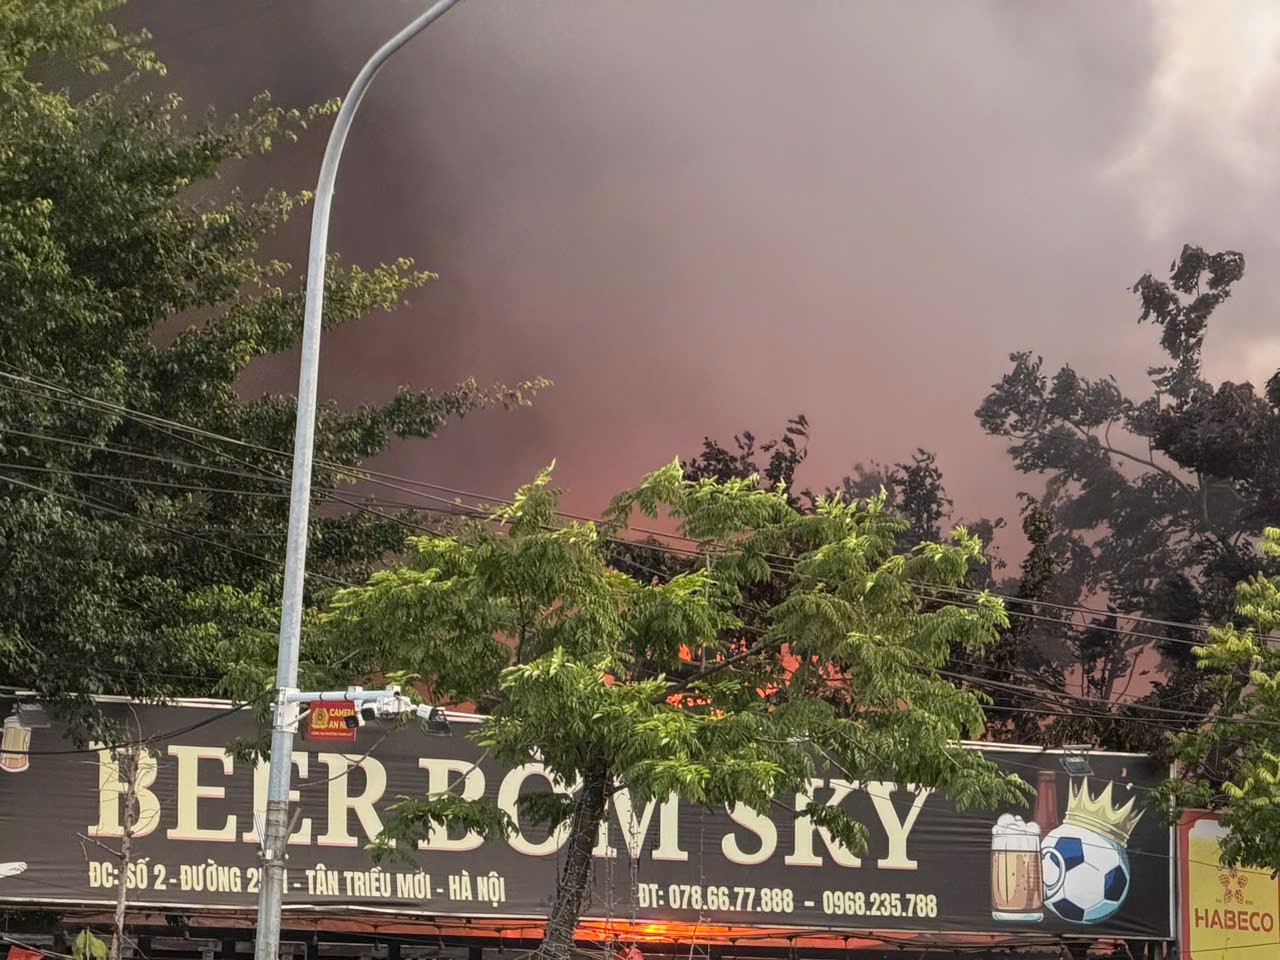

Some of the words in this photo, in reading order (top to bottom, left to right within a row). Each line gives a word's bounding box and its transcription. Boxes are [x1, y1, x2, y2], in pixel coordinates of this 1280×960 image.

[87, 741, 396, 847] BEER
[721, 776, 936, 870] SKY
[89, 861, 119, 888] ĐC:
[125, 857, 150, 889] SỐ
[153, 864, 167, 890] 2
[180, 858, 242, 893] ĐƯỜNG
[305, 863, 339, 895] TÂN
[343, 866, 391, 897] TRIỀU
[449, 869, 473, 900] HÀ
[477, 871, 506, 907] NỘI
[668, 884, 794, 913] 078.66.77.888
[822, 890, 938, 918] 0968.235.788
[1194, 908, 1274, 932] HABECO
